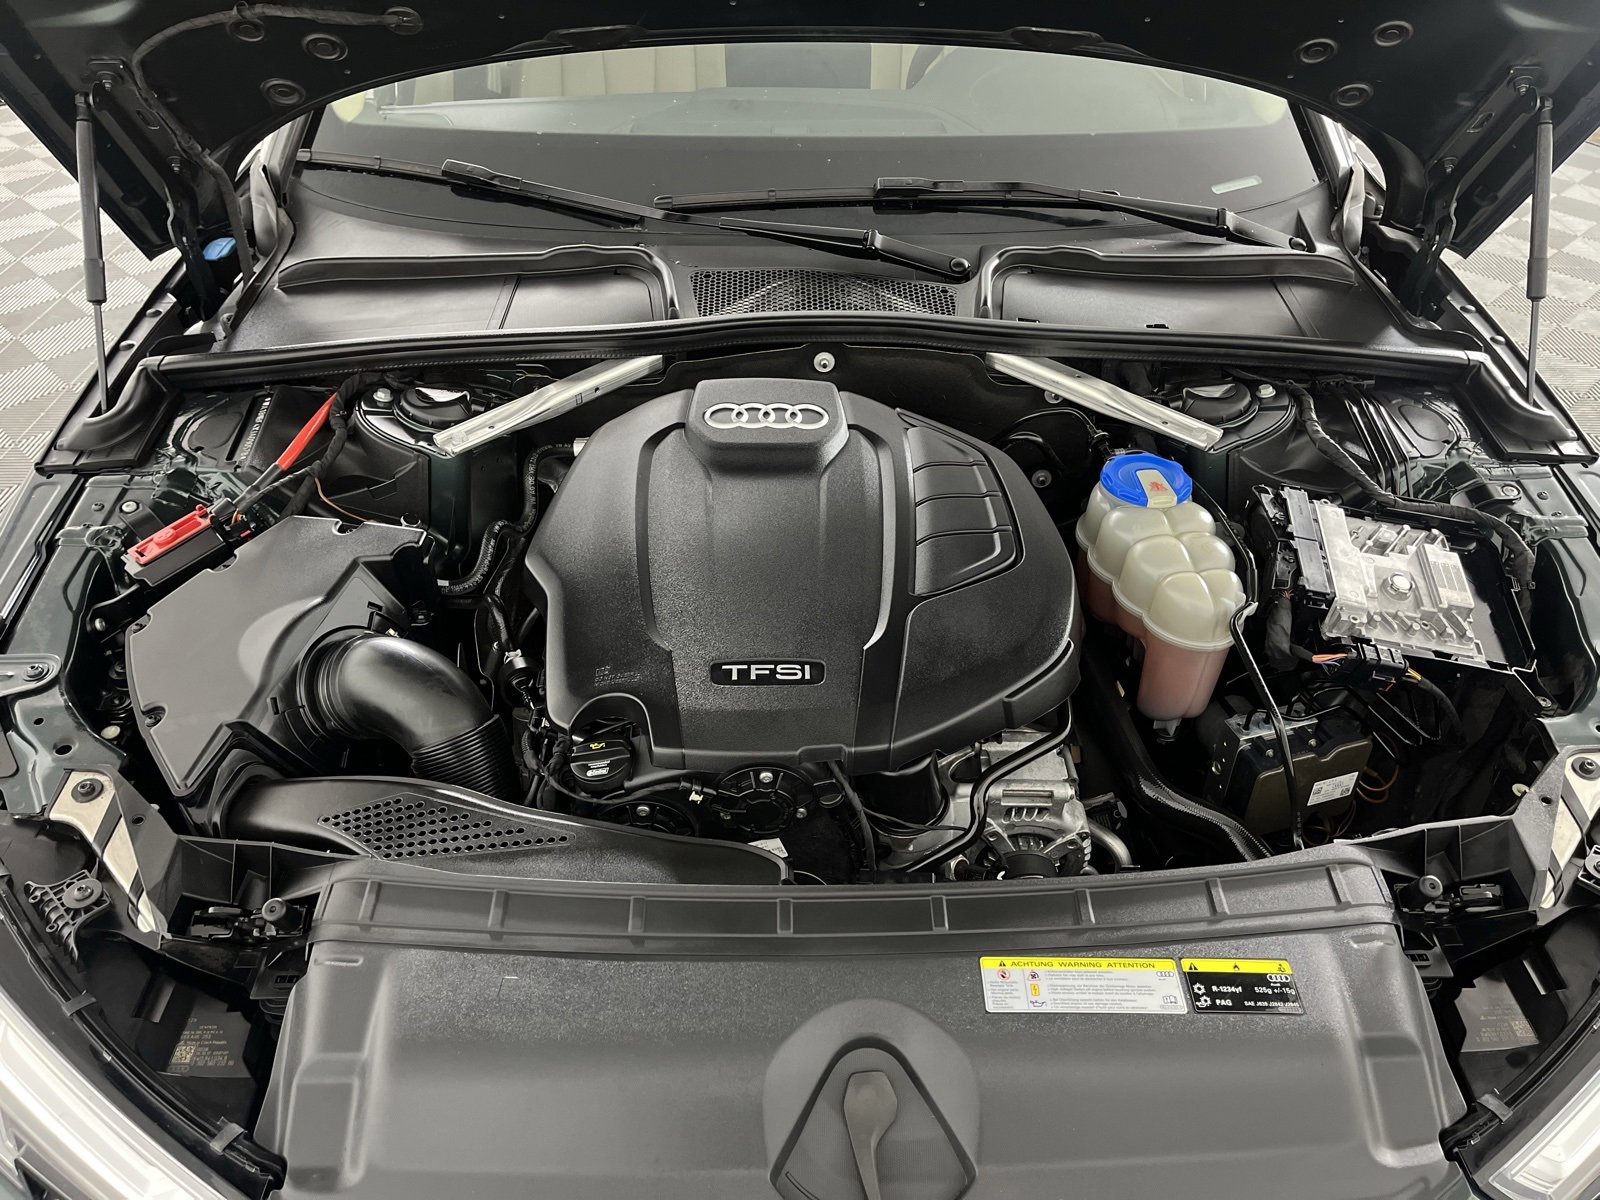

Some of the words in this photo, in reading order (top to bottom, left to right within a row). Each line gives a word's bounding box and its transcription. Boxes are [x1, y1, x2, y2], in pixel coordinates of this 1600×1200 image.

[721, 664, 811, 680] TFSI
[1010, 960, 1054, 968] ACHTUNG
[1057, 960, 1102, 969] WARNING
[1106, 961, 1156, 969] ATTENTION
[1254, 986, 1273, 995] 525g
